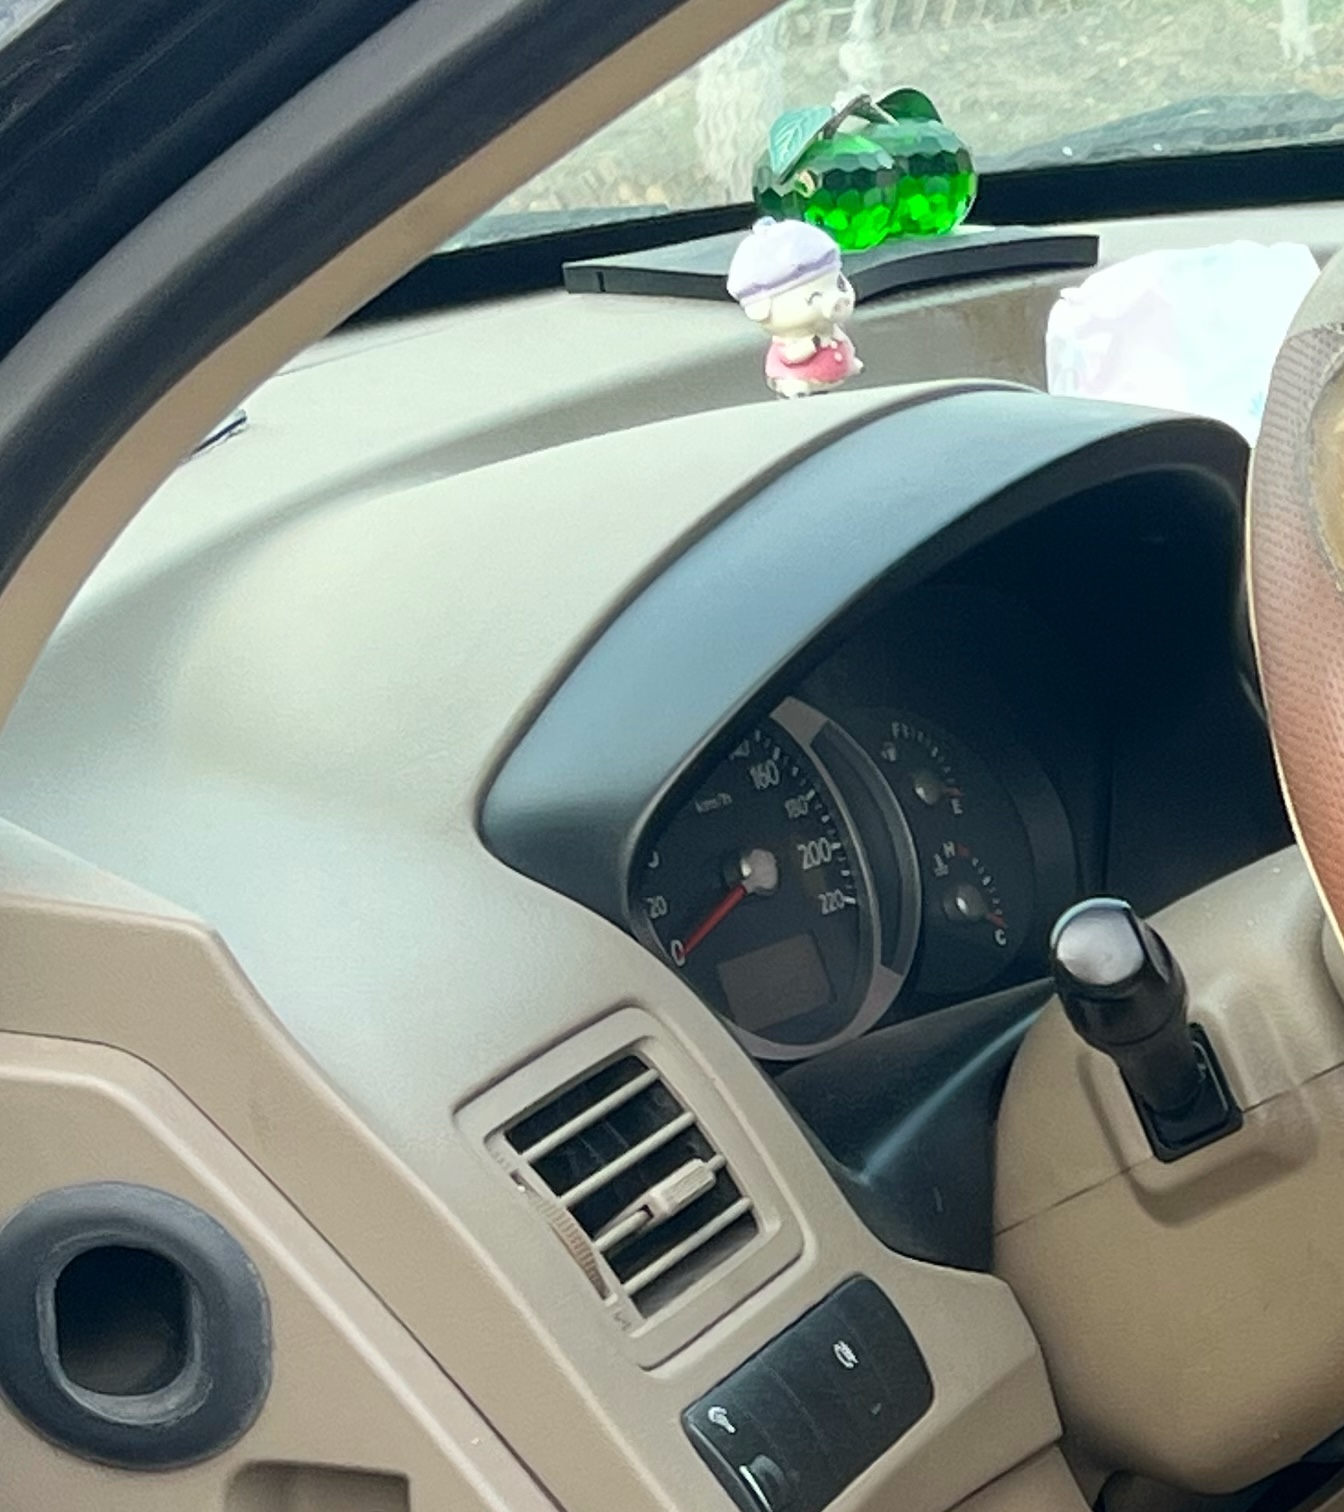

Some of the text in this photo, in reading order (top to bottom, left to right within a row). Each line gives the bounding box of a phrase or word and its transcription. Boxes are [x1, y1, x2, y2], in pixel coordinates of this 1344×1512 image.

[750, 760, 780, 790] 160
[951, 799, 963, 815] E
[796, 837, 833, 871] 200
[645, 895, 668, 919] 20
[818, 889, 846, 915] 220
[995, 929, 1007, 946] C
[669, 939, 686, 966] 0
